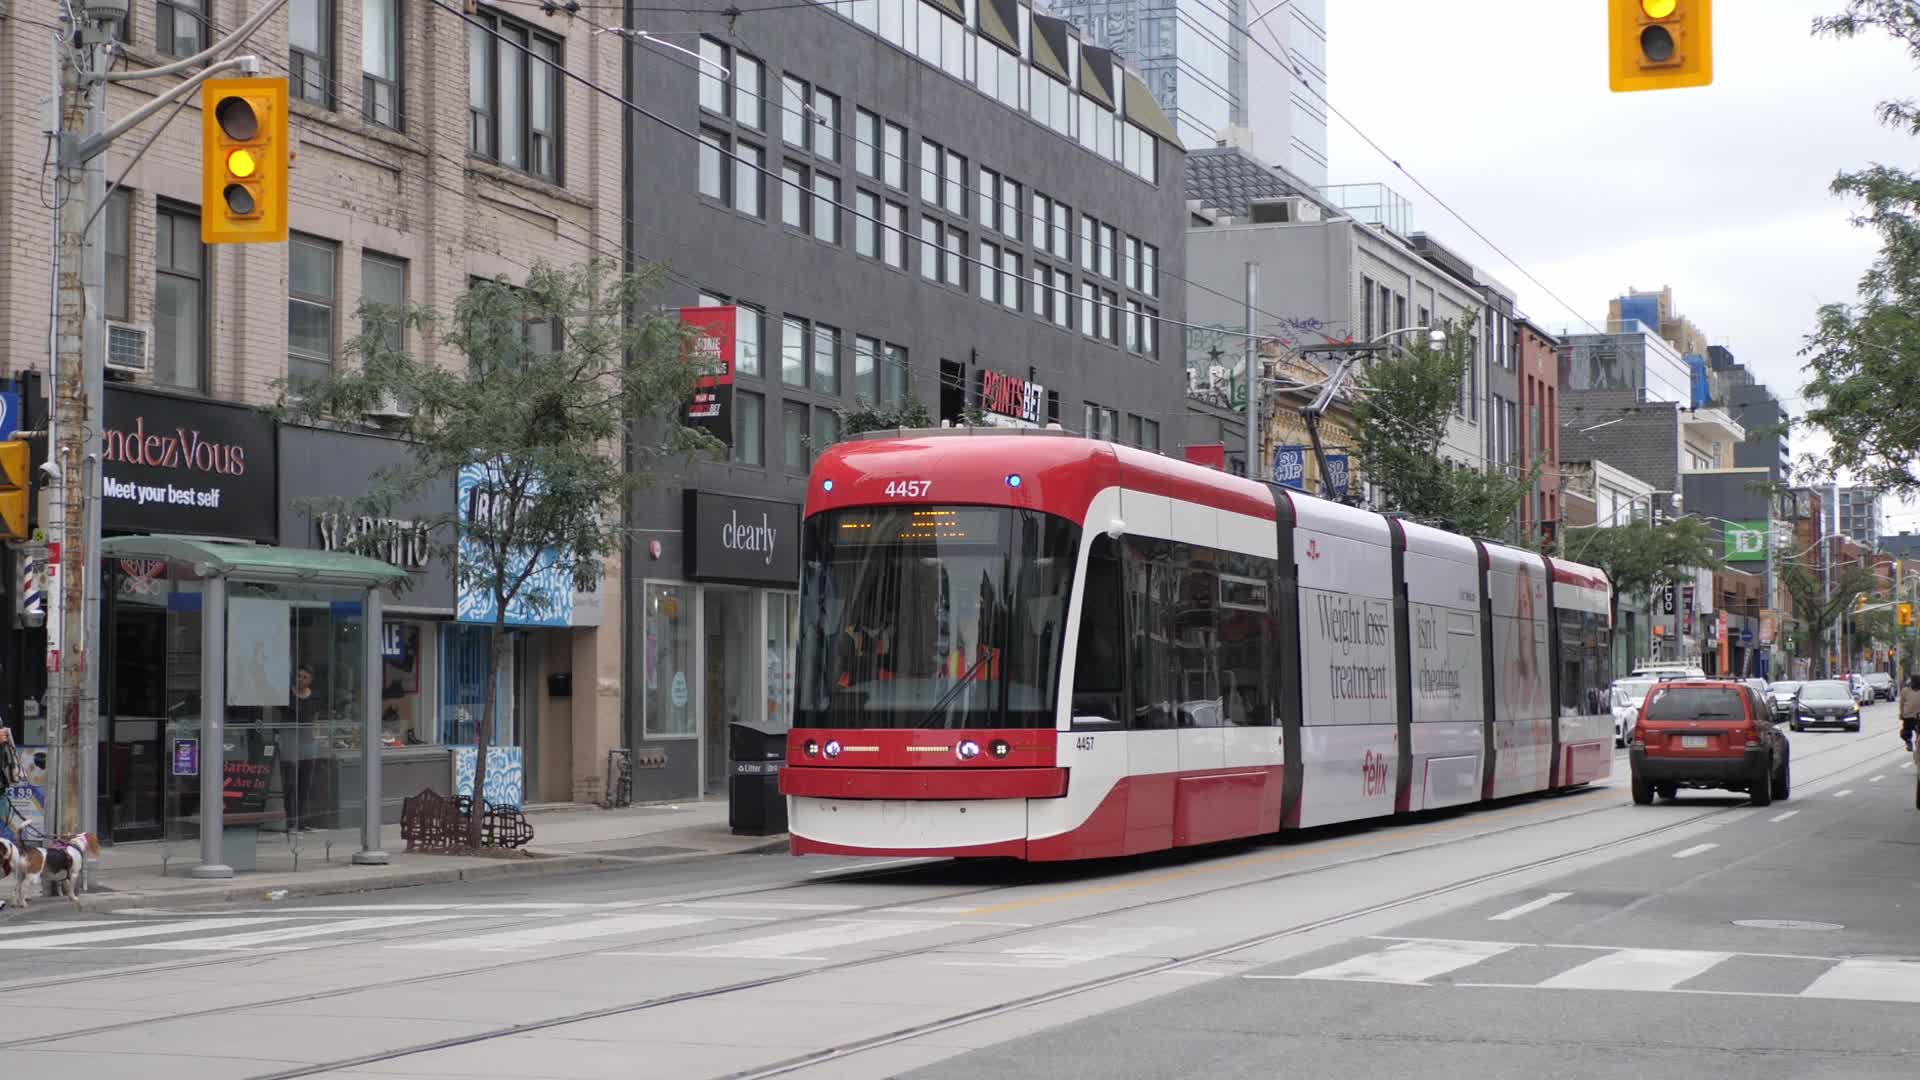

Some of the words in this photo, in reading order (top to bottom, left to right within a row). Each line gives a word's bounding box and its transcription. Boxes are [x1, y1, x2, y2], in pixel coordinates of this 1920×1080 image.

[983, 369, 1042, 421] POINTSBET
[1279, 451, 1298, 466] SO
[1327, 460, 1344, 474] SO
[103, 476, 137, 500] Meet
[138, 485, 167, 505] your
[168, 484, 196, 506] best
[197, 488, 221, 508] self
[884, 480, 932, 498] 4457
[722, 509, 777, 565] clearly
[1727, 529, 1763, 553] TD
[380, 623, 401, 656] LE
[1316, 593, 1362, 657] Weight
[1363, 600, 1388, 648] loss
[1329, 659, 1388, 700] treatment
[1076, 736, 1095, 751] 4457
[1362, 749, 1389, 798] felix
